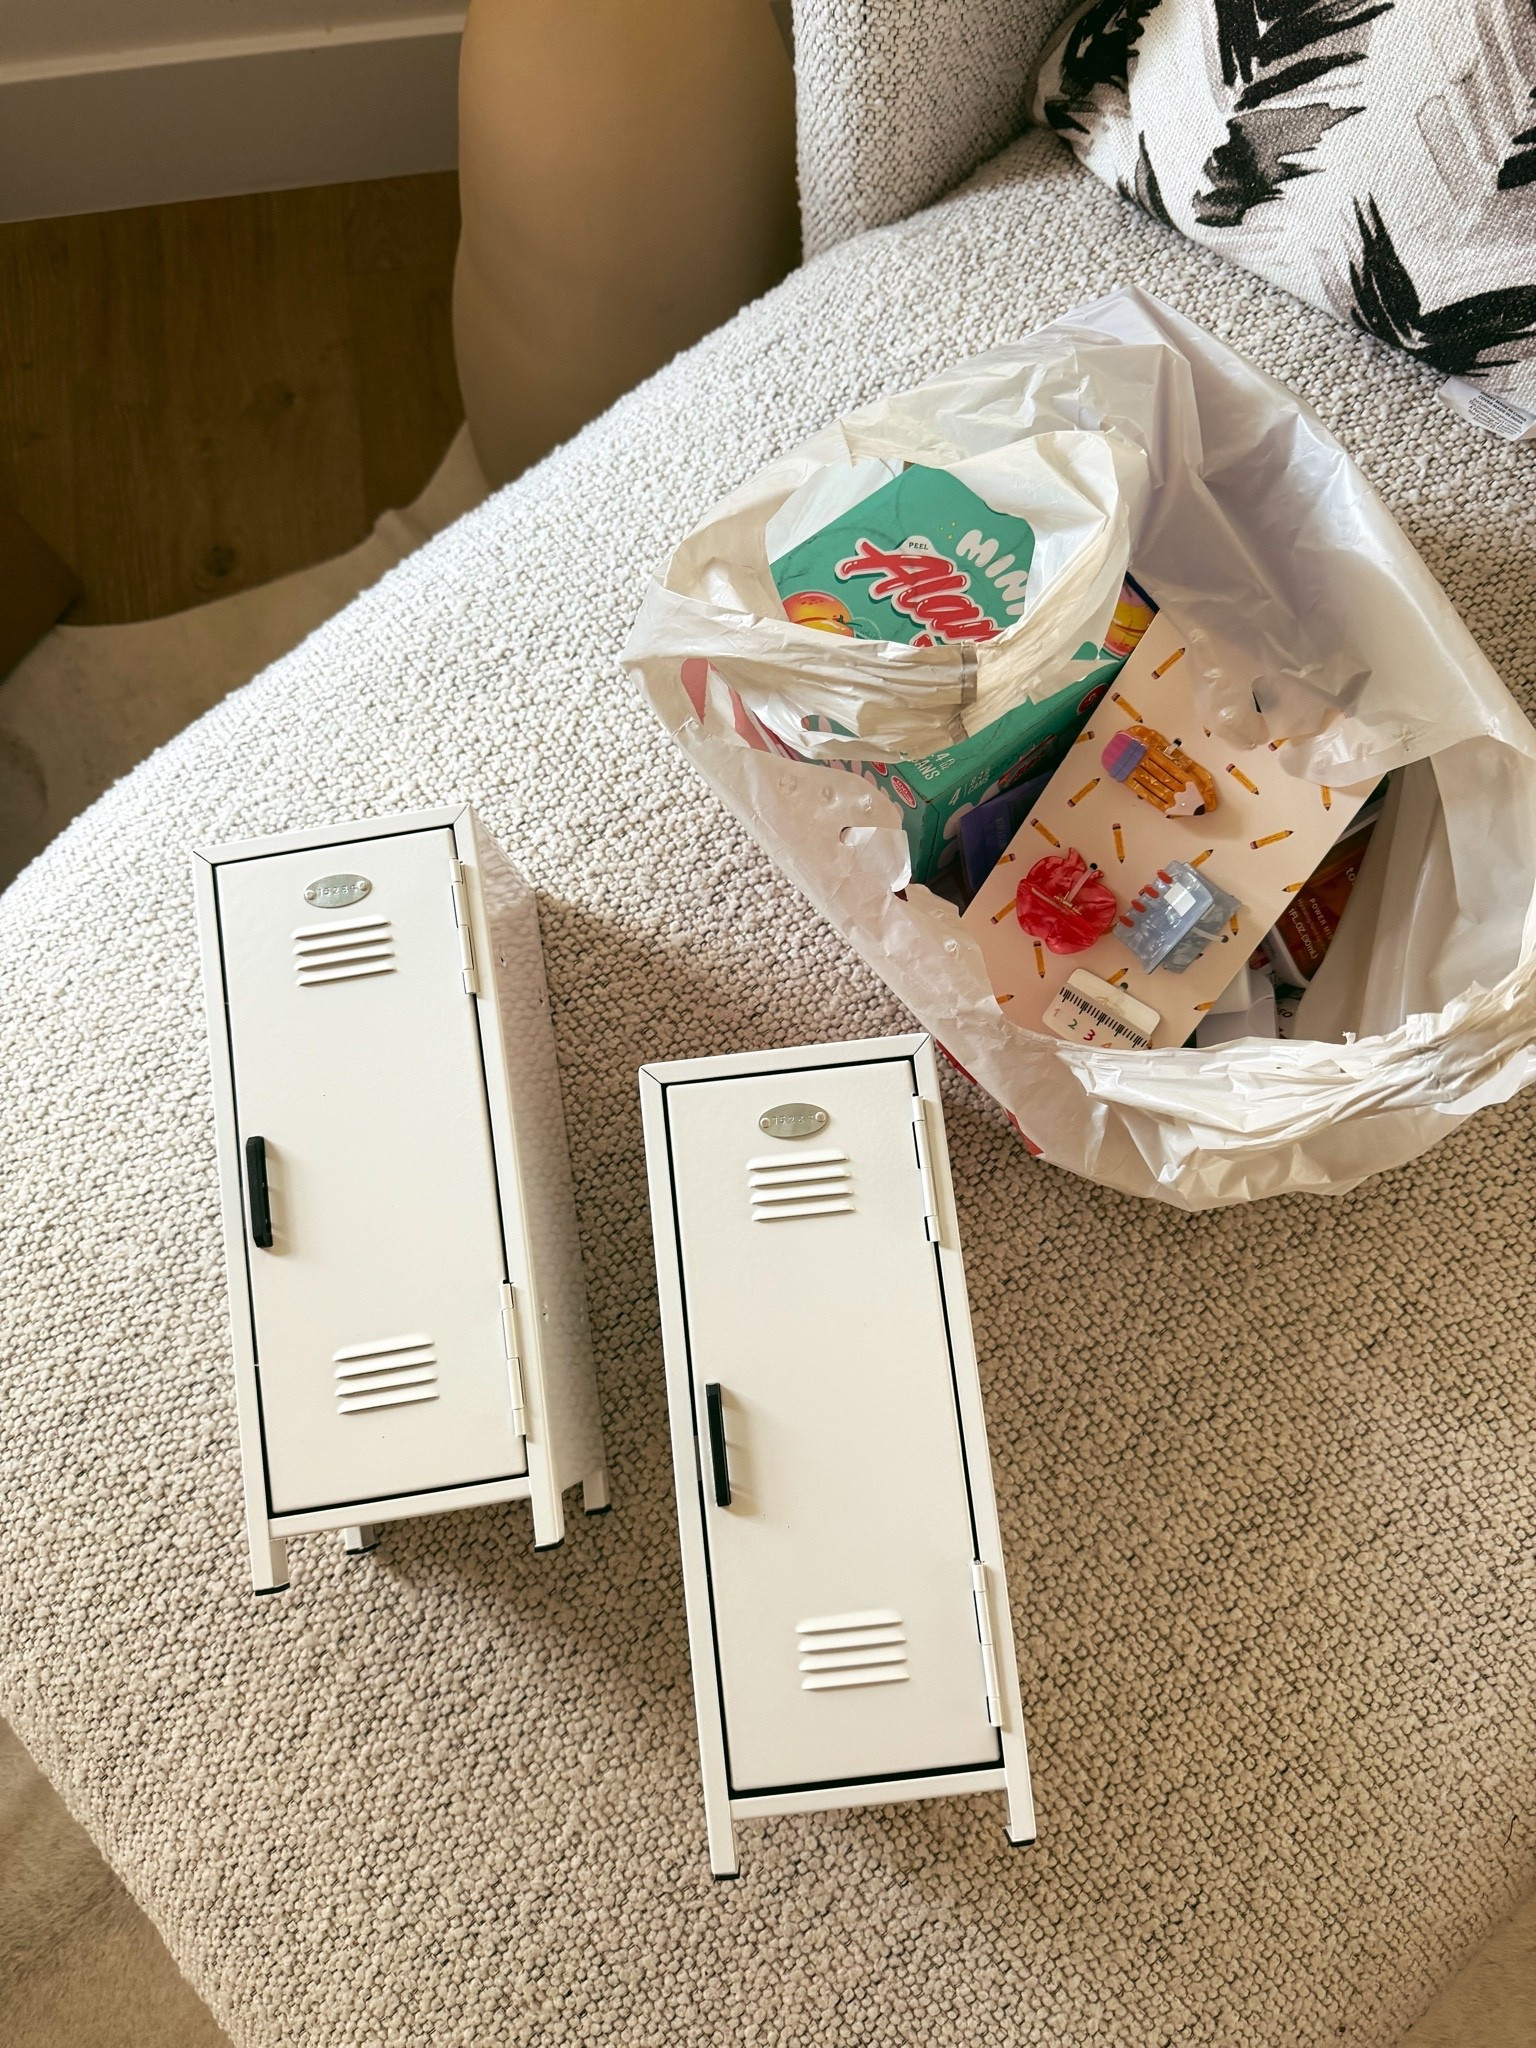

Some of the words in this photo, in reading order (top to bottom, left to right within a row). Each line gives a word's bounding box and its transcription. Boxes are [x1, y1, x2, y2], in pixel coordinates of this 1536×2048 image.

[908, 541, 929, 551] PEEL
[1308, 897, 1327, 925] POWER
[1068, 1018, 1078, 1030] 2
[1083, 1029, 1096, 1041] 3
